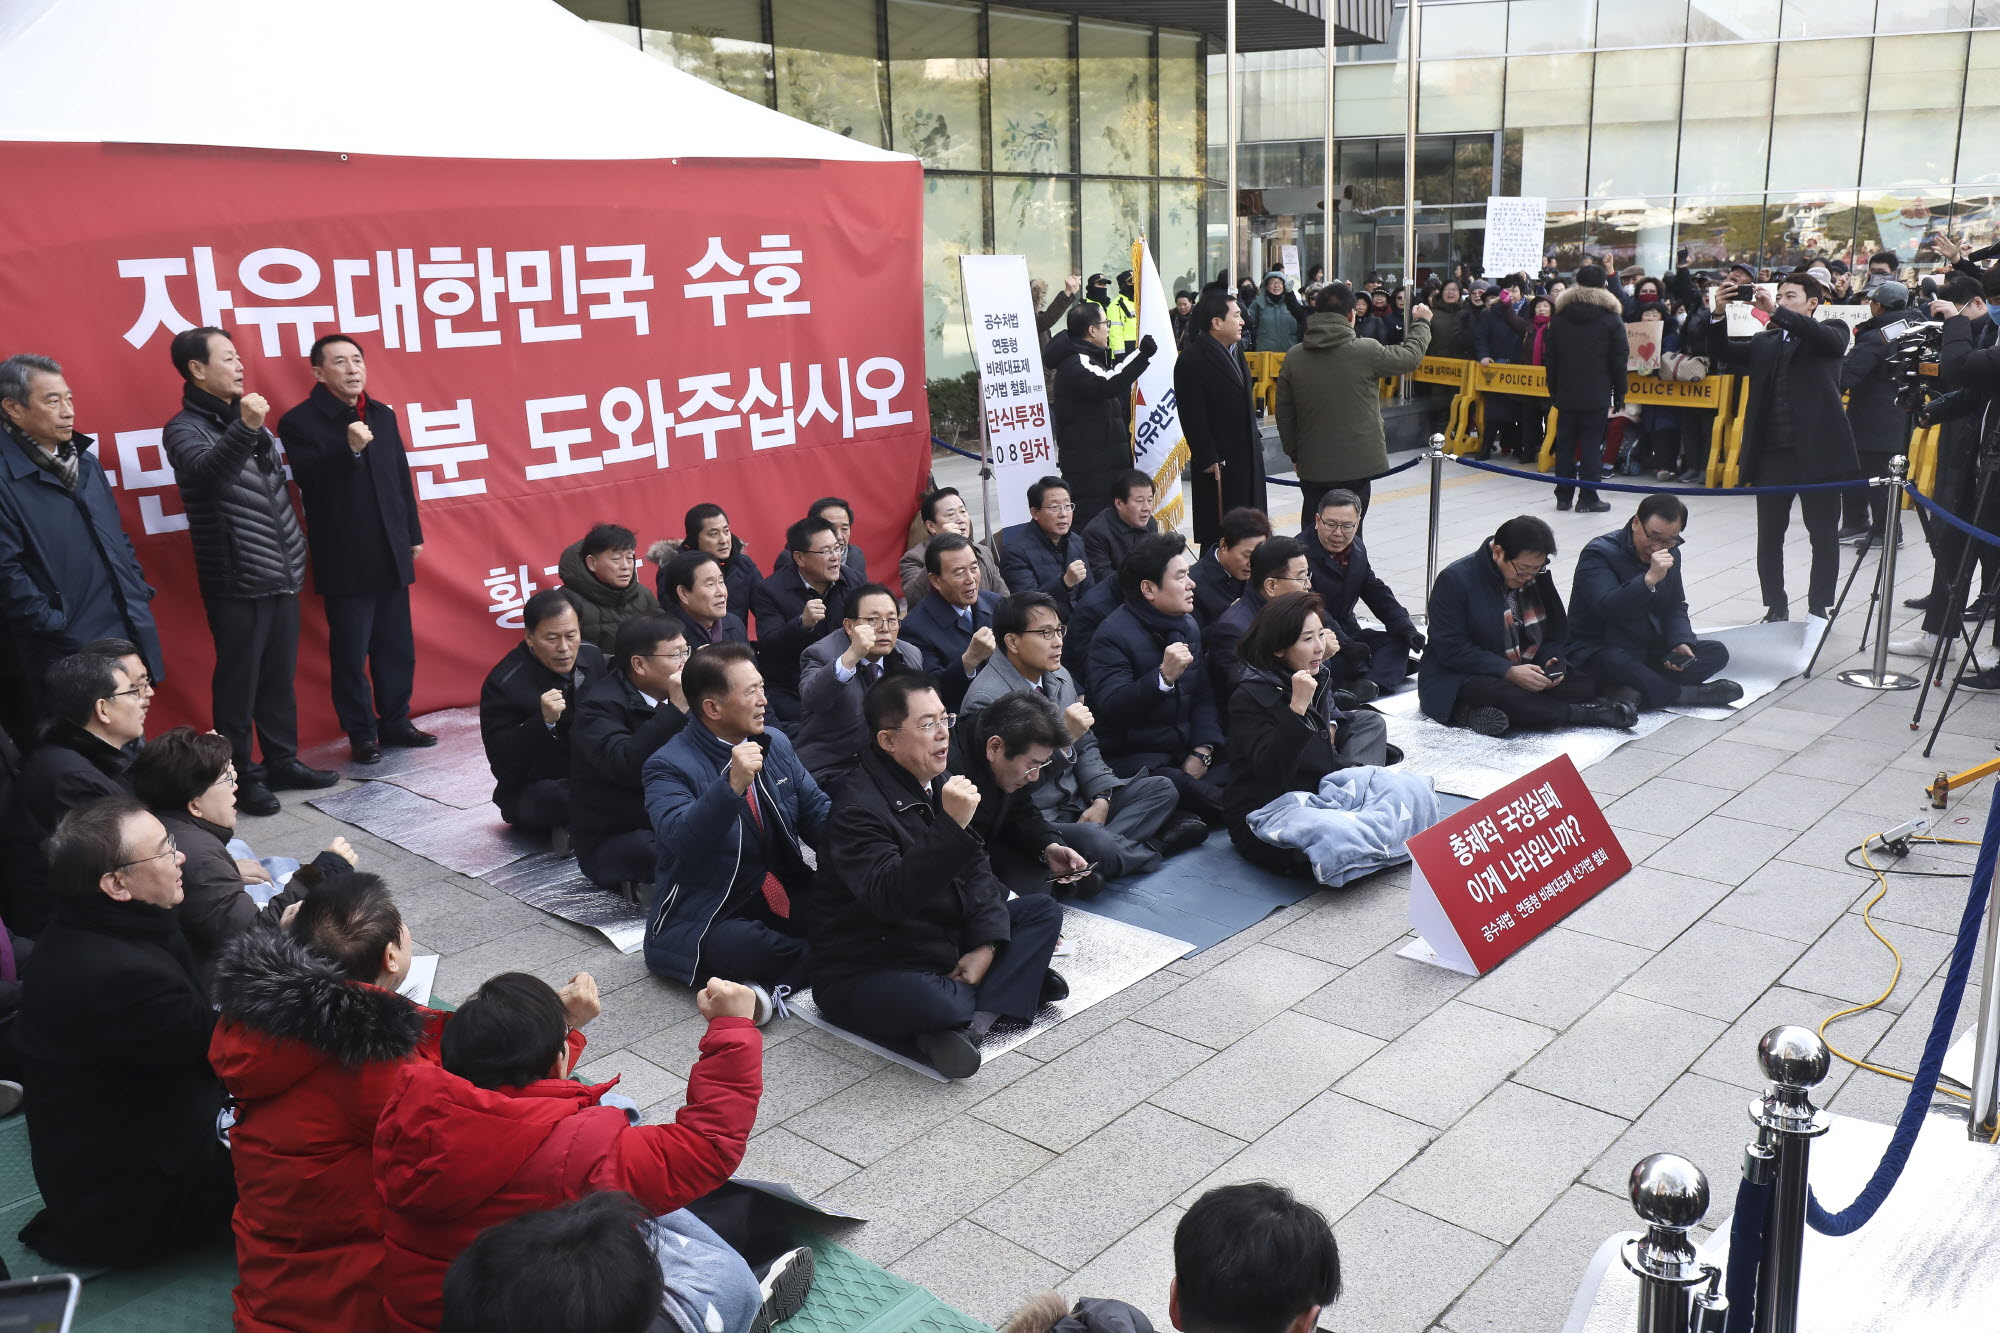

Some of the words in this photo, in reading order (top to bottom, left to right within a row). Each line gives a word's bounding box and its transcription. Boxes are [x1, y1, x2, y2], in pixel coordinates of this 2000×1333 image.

[117, 244, 654, 358] 자유대한민국
[684, 235, 811, 327] 수호
[984, 313, 1019, 330] 공수처법
[992, 338, 1018, 354] 연동형
[986, 358, 1031, 376] 비례대표제
[984, 382, 1008, 399] 선거법
[1500, 373, 1533, 386] POLICE
[1630, 382, 1674, 396] OLICE
[1680, 384, 1712, 398] LINE
[525, 357, 913, 481] 도와주십시오
[987, 403, 1046, 433] 단식투쟁
[1449, 815, 1505, 867] 총체적
[1496, 781, 1563, 834] 국정실패
[1466, 863, 1508, 904] 이게
[1500, 814, 1586, 882] 나라입니까?
[1481, 911, 1516, 943] 공수처법
[1515, 893, 1542, 919] 연동형
[1537, 869, 1576, 901] 비례대표제
[1571, 857, 1596, 880] 선거법
[1592, 847, 1610, 867] 철회
